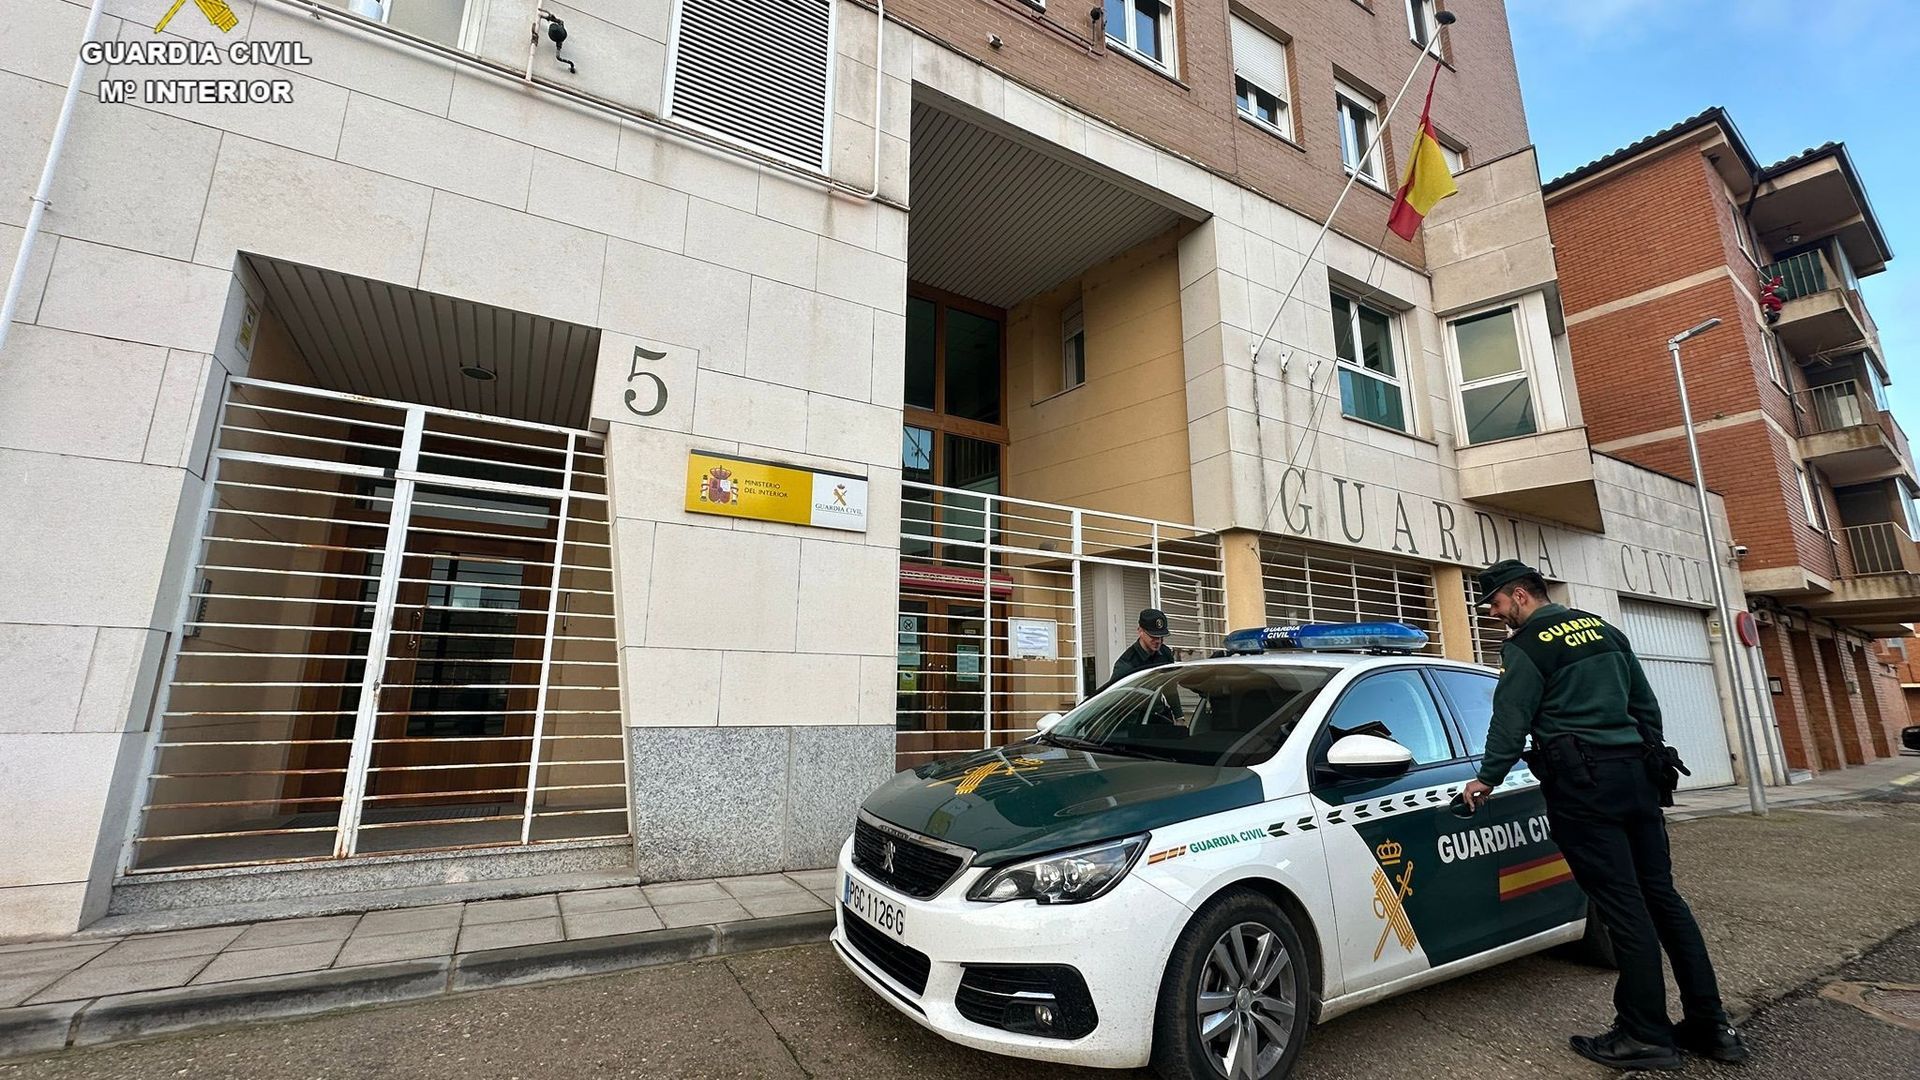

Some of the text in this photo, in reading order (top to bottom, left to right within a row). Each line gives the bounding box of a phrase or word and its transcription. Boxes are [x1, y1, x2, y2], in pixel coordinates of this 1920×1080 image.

[624, 345, 668, 417] 5
[744, 479, 781, 489] MINISTERIO
[744, 487, 788, 498] DEL INTERIOR
[815, 503, 844, 512] GUARDIA
[1280, 467, 1713, 603] GUARDIA CIVIL
[1267, 631, 1289, 639] CIVIL
[1538, 617, 1604, 642] GUARDIA
[1565, 629, 1603, 647] CIVIL
[1189, 828, 1267, 853] GUARDIA CIVIL
[1437, 821, 1527, 864] GUARDIA
[850, 881, 865, 912] PGC
